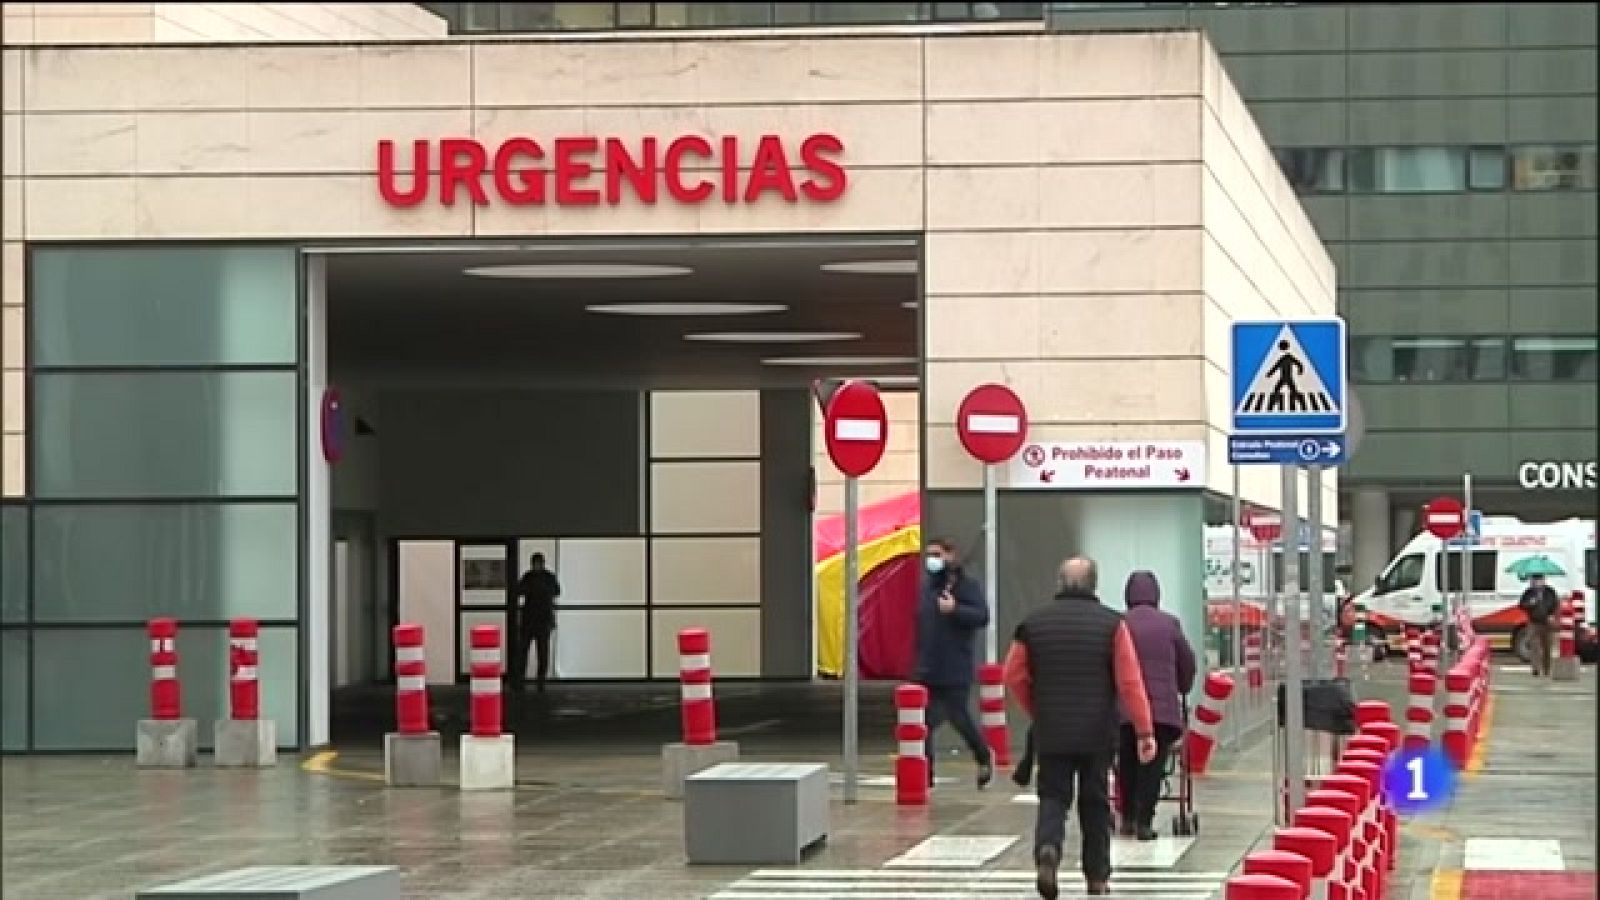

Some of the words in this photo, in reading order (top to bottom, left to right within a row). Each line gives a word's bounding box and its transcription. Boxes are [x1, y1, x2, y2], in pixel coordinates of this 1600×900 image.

[377, 134, 848, 207] URGENCIAS
[1052, 445, 1123, 460] Prohibido
[1127, 446, 1141, 460] el
[1145, 445, 1183, 460] Paso
[1084, 464, 1151, 479] Peatonal
[1520, 462, 1597, 488] CONS
